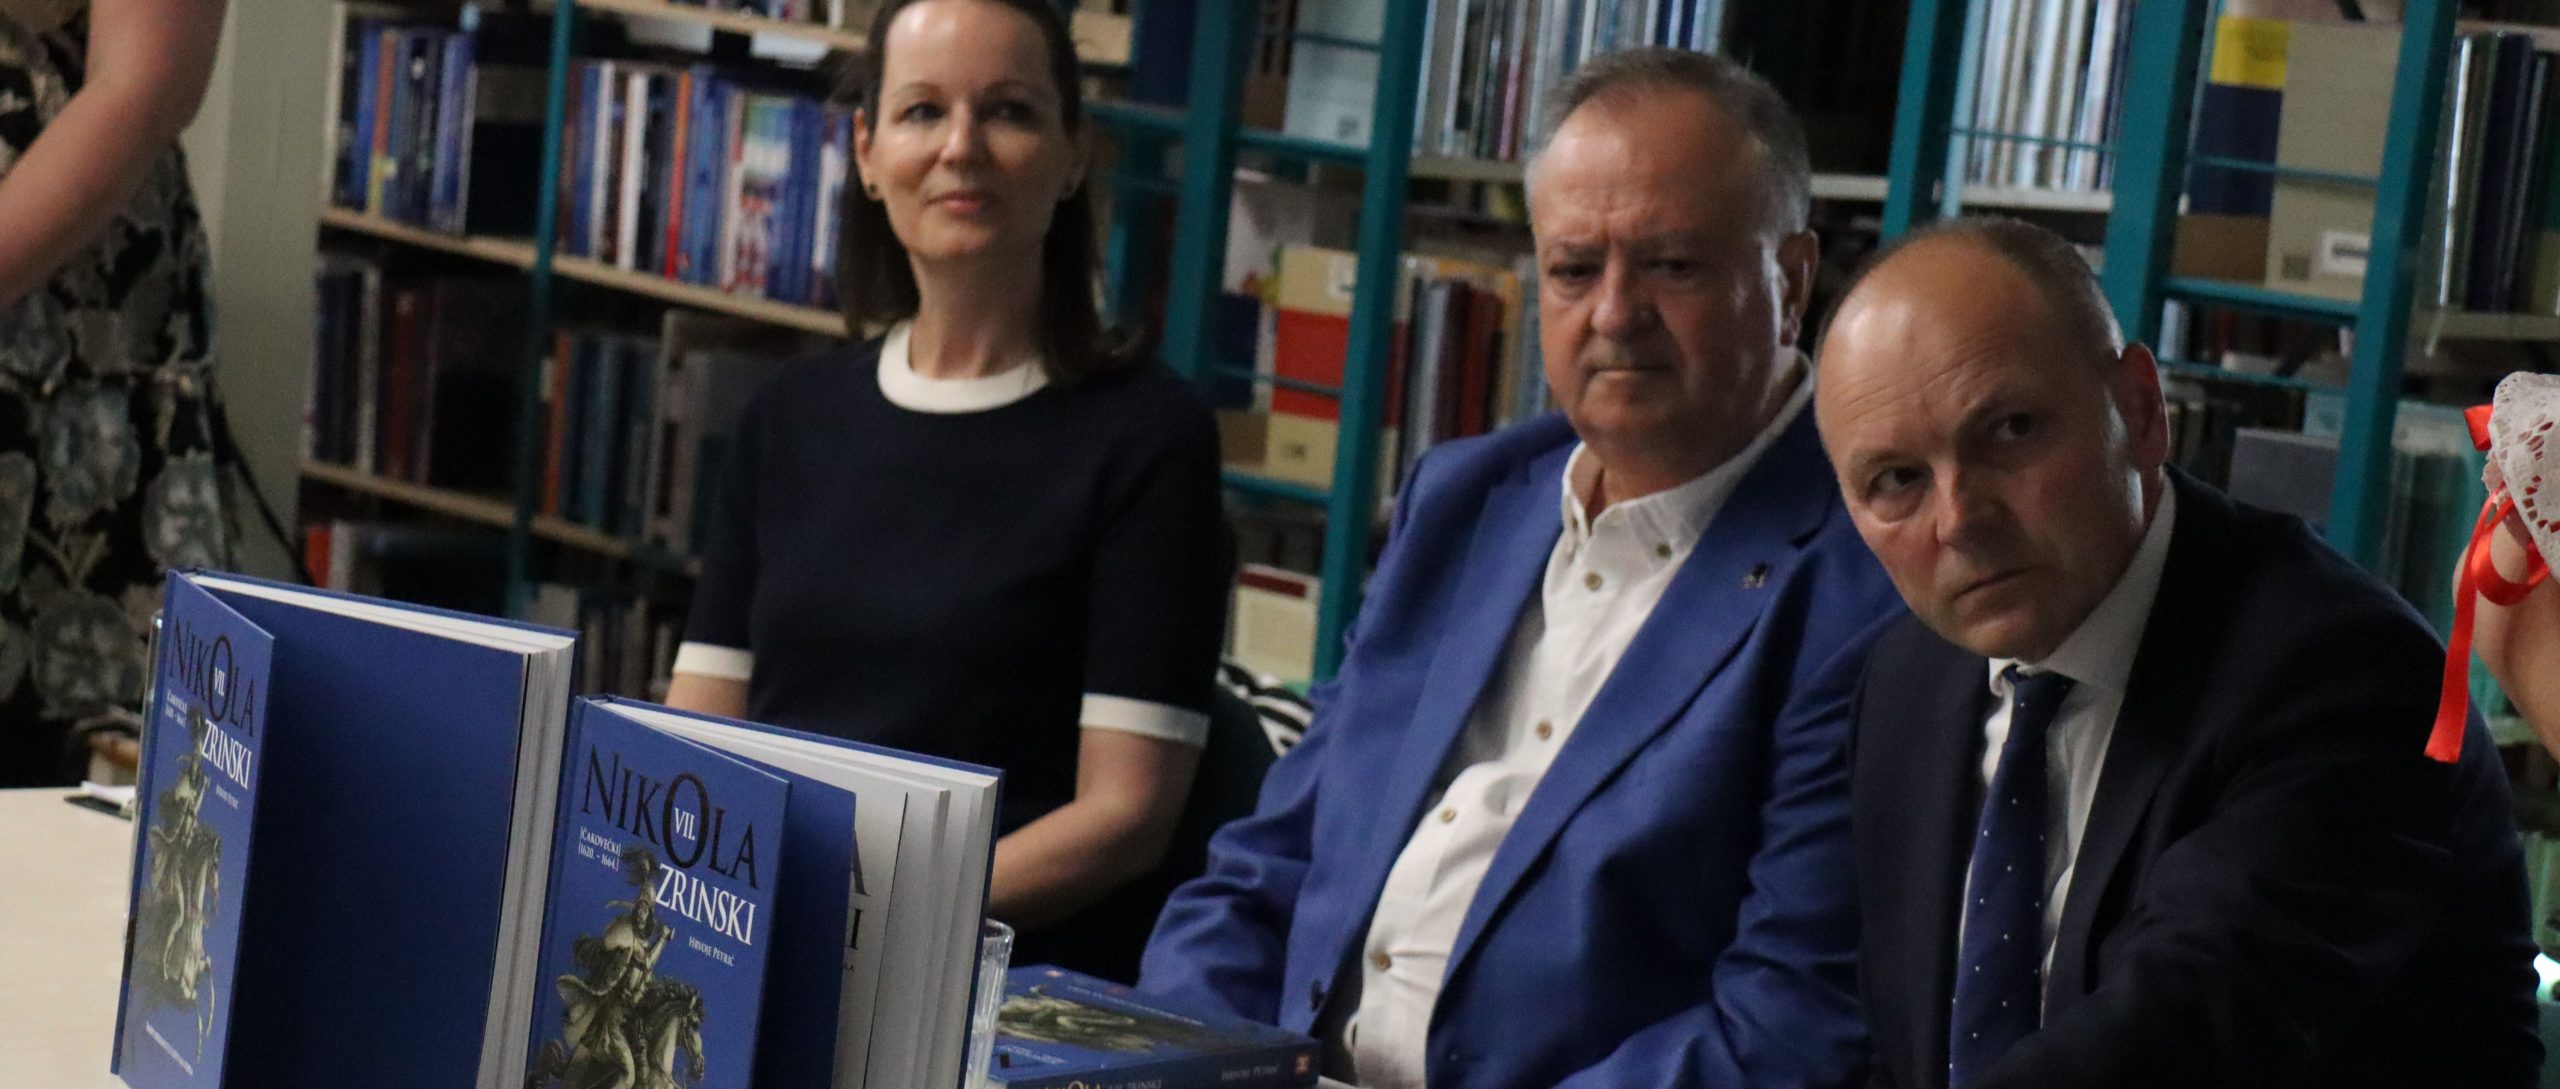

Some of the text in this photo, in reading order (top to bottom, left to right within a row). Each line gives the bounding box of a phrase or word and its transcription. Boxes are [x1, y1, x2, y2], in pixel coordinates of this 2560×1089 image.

[168, 615, 254, 738] NIKOLA
[201, 718, 253, 790] ZRINSKI
[581, 744, 759, 890] NIKOLA
[674, 807, 696, 841] VII.
[655, 862, 757, 947] ZRINSKI
[688, 936, 735, 967] HRVOJE PETRIĆ
